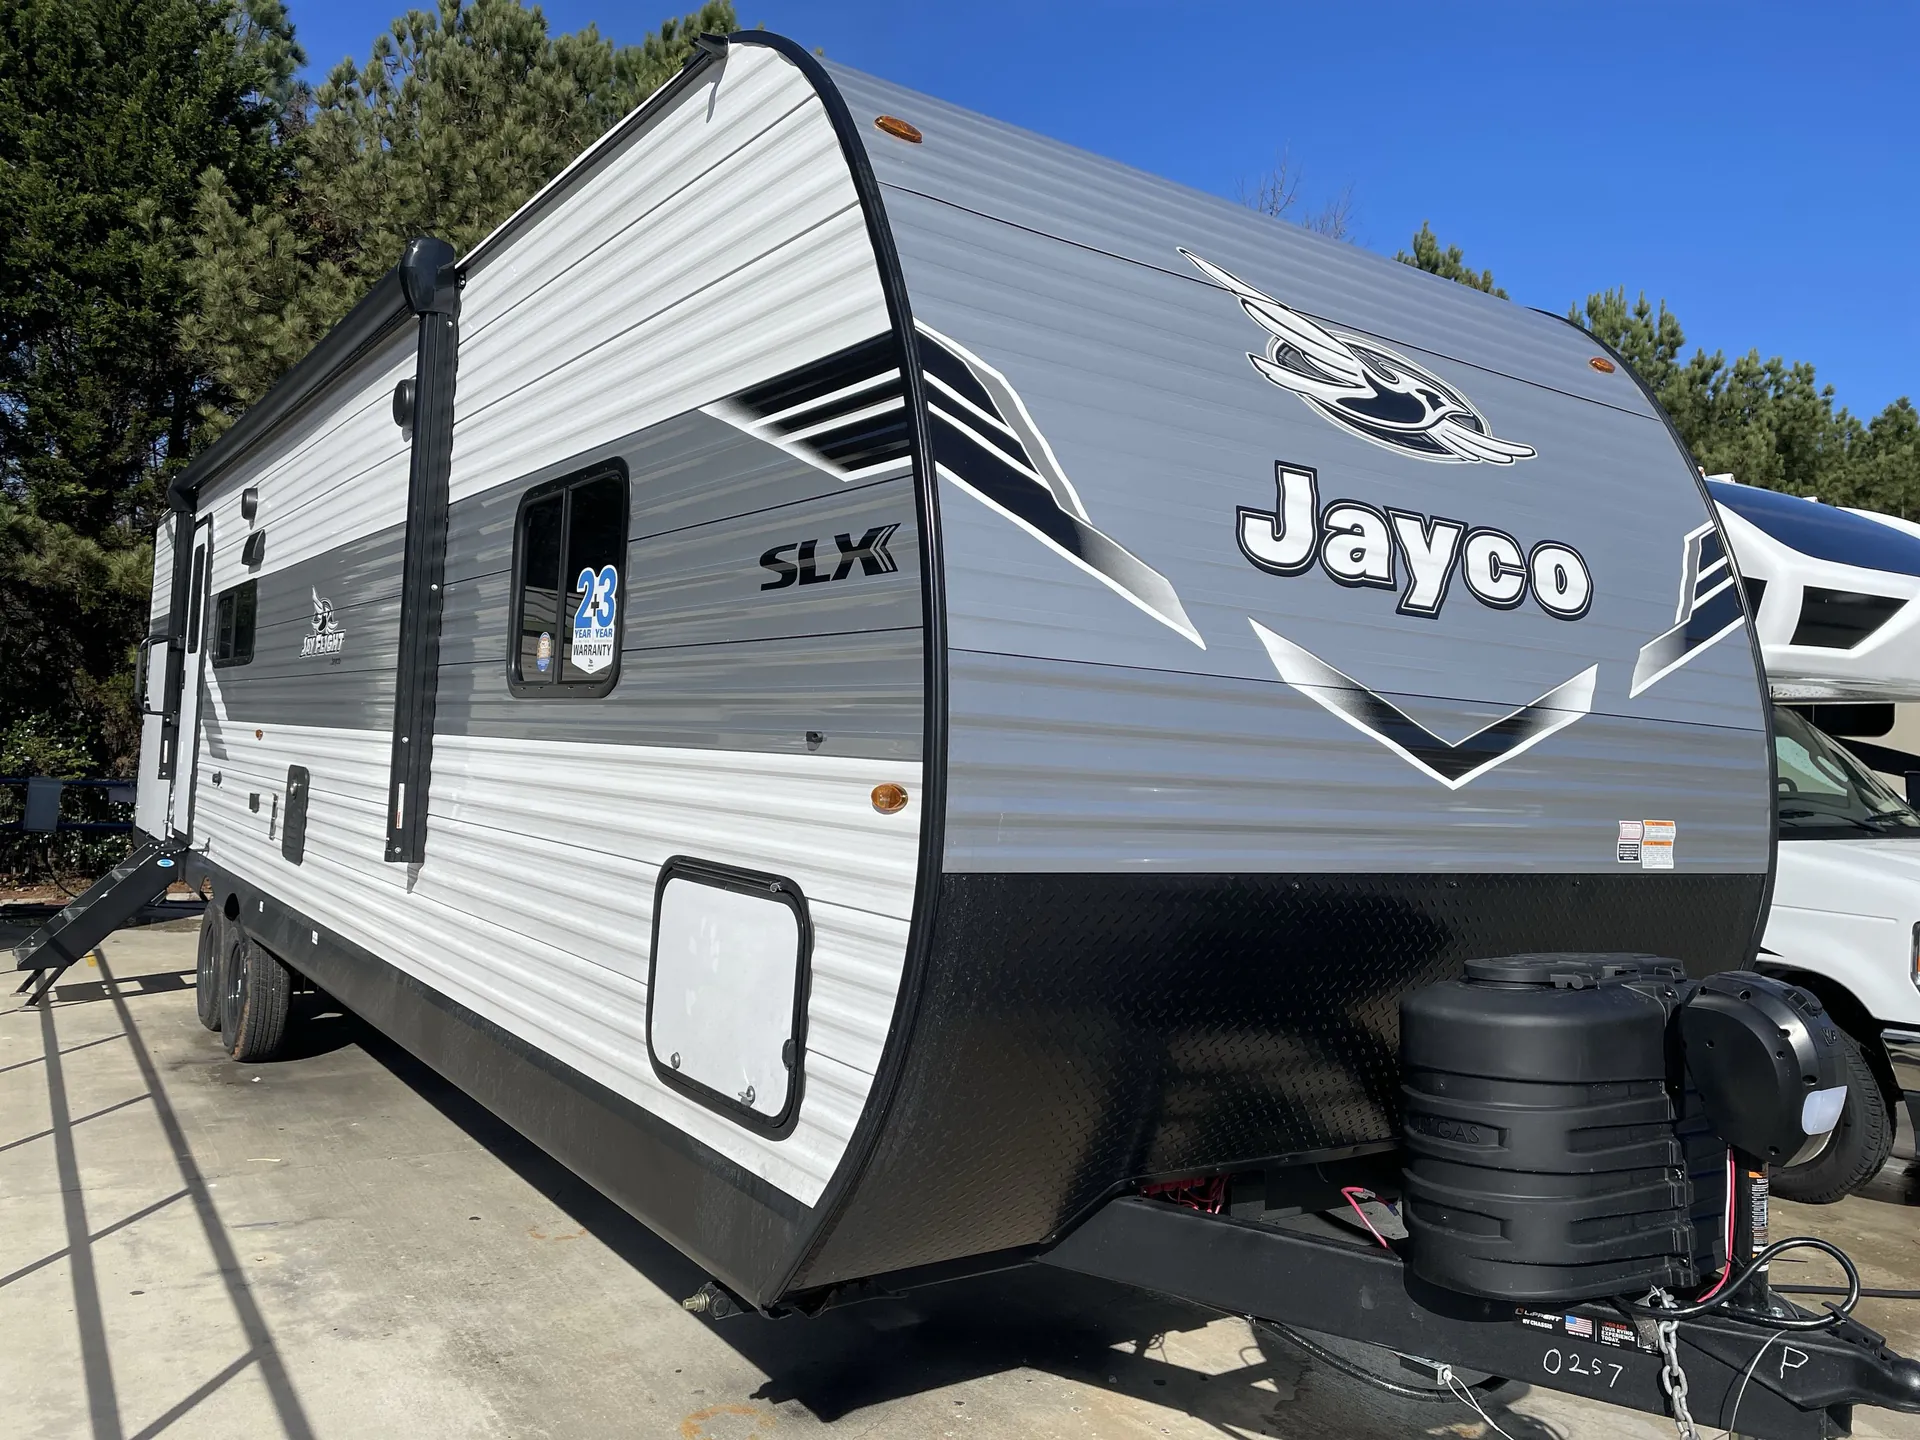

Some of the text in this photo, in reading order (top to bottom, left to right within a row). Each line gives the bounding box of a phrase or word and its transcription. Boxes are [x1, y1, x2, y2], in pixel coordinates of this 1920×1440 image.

[1236, 460, 1594, 620] Jayco
[759, 522, 901, 591] SLX
[574, 628, 613, 639] YEAR YEAR
[299, 630, 346, 658] JAY FLIGHT
[573, 643, 613, 656] WARRANTY
[1436, 1120, 1481, 1144] GAS
[1522, 1318, 1553, 1330] RV CHASSIS
[1601, 1325, 1616, 1333] YOUR
[1601, 1330, 1636, 1342] EXPERIENCE
[1779, 1345, 1810, 1380] P
